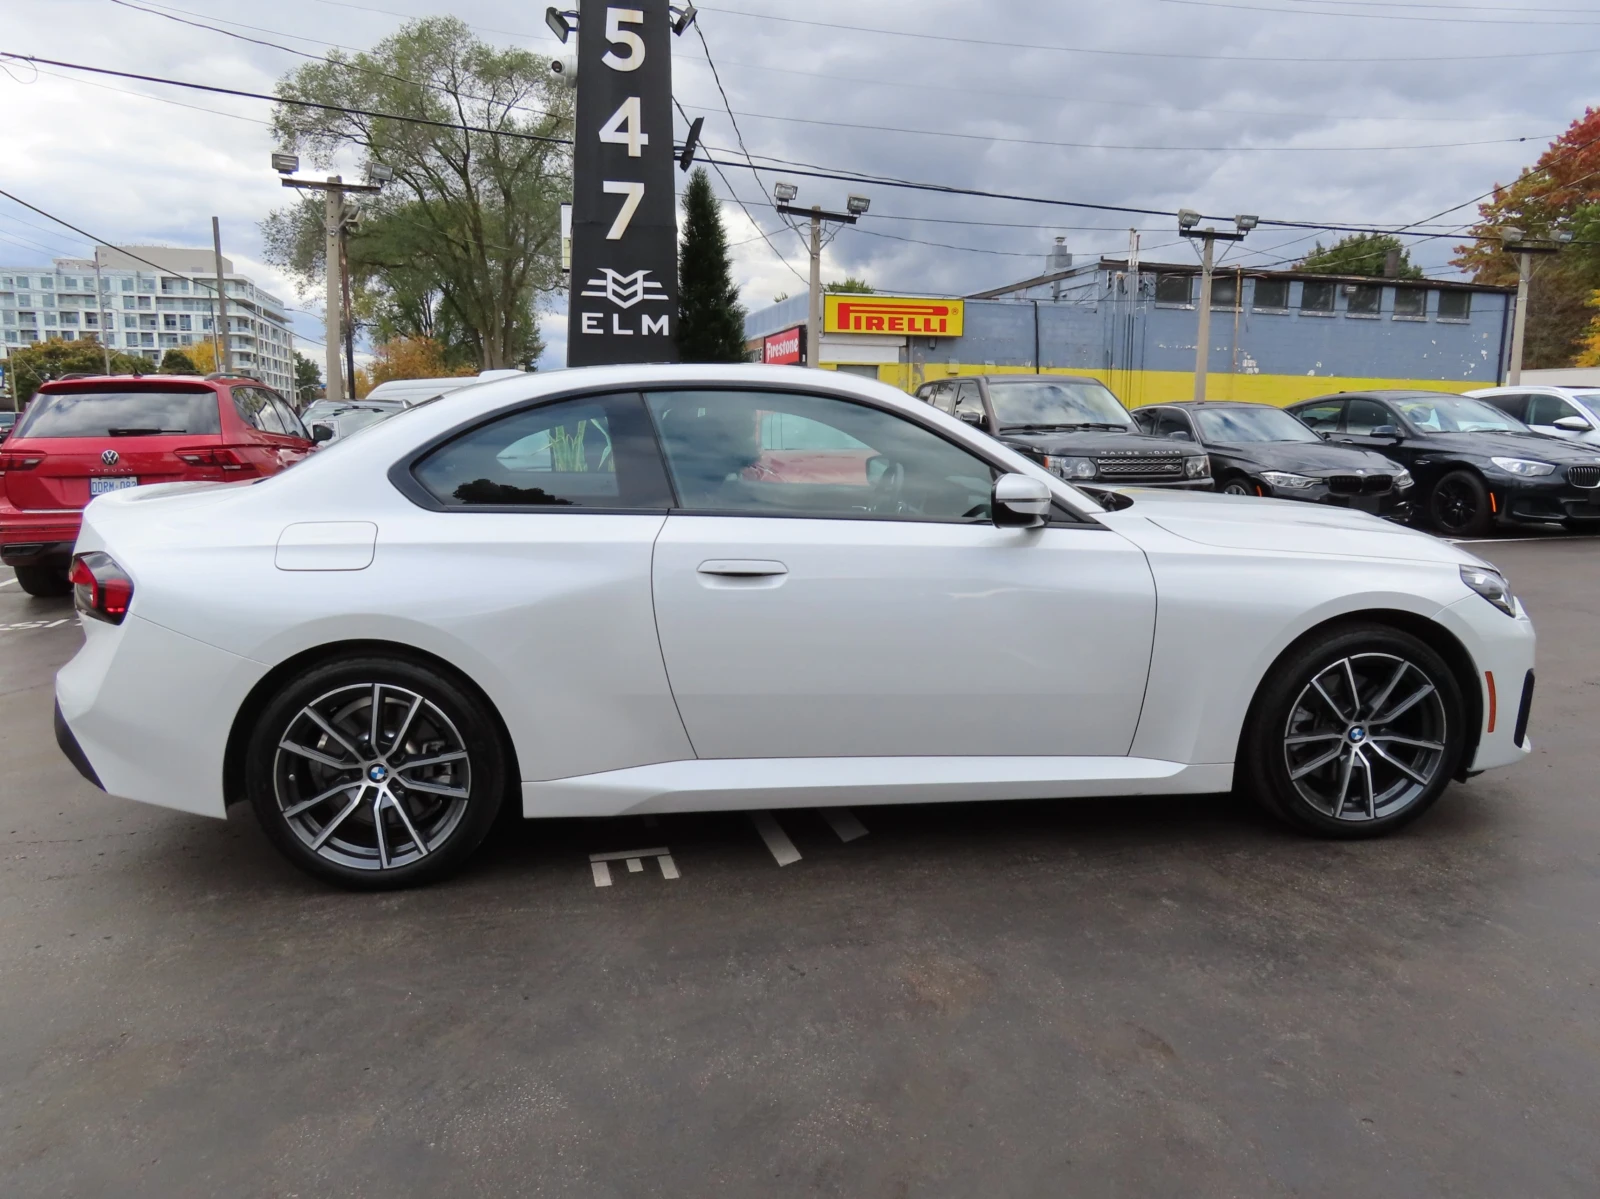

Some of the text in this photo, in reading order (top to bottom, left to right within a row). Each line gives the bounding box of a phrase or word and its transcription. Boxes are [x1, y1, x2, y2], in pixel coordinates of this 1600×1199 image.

[581, 312, 669, 336] ELM
[837, 302, 949, 333] PIRELLI
[766, 338, 799, 364] Firestone
